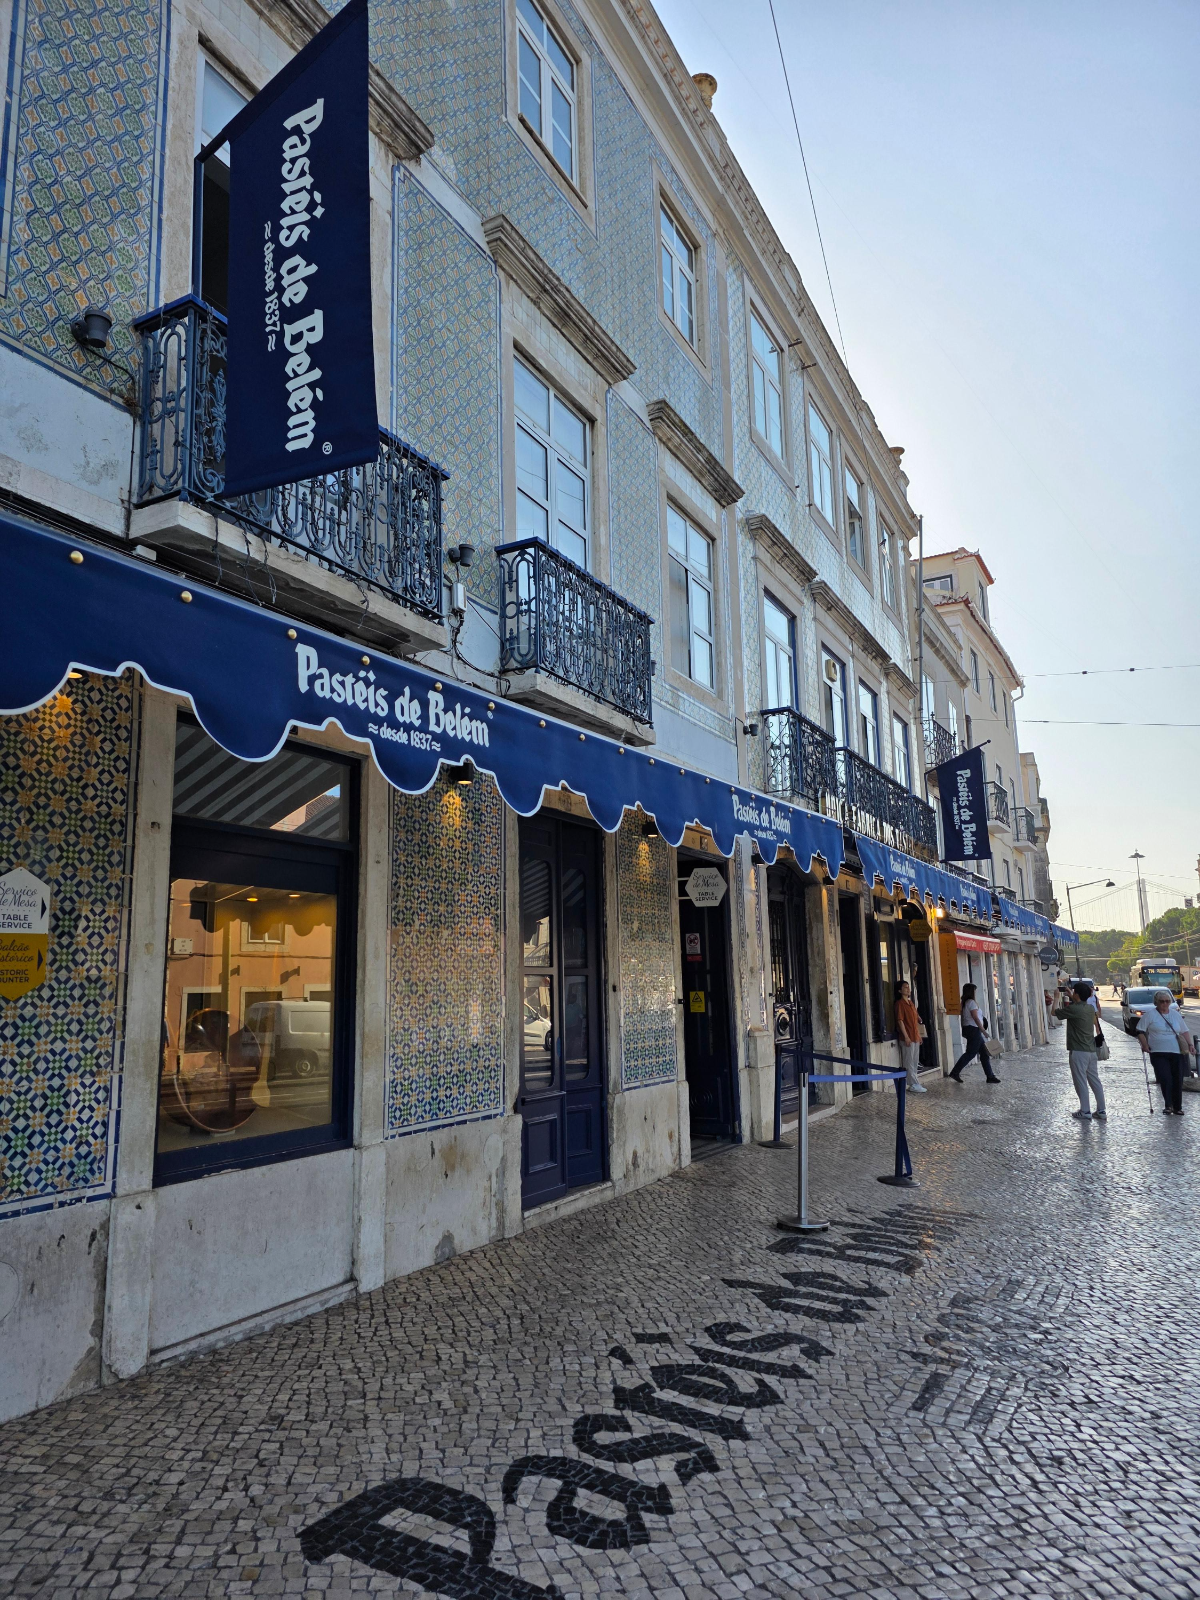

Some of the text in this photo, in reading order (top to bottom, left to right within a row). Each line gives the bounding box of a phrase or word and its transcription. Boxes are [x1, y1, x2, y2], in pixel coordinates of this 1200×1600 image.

[263, 241, 281, 333] desde 1837
[279, 98, 325, 453] Pastéis de Belém
[295, 643, 490, 748] Pastéis de Belém
[380, 722, 432, 751] desde 1837
[760, 806, 770, 828] de
[956, 768, 977, 855] Pastéis de Belém
[1, 913, 29, 922] TABLE
[9, 895, 38, 908] Mesa
[722, 1270, 891, 1324] de
